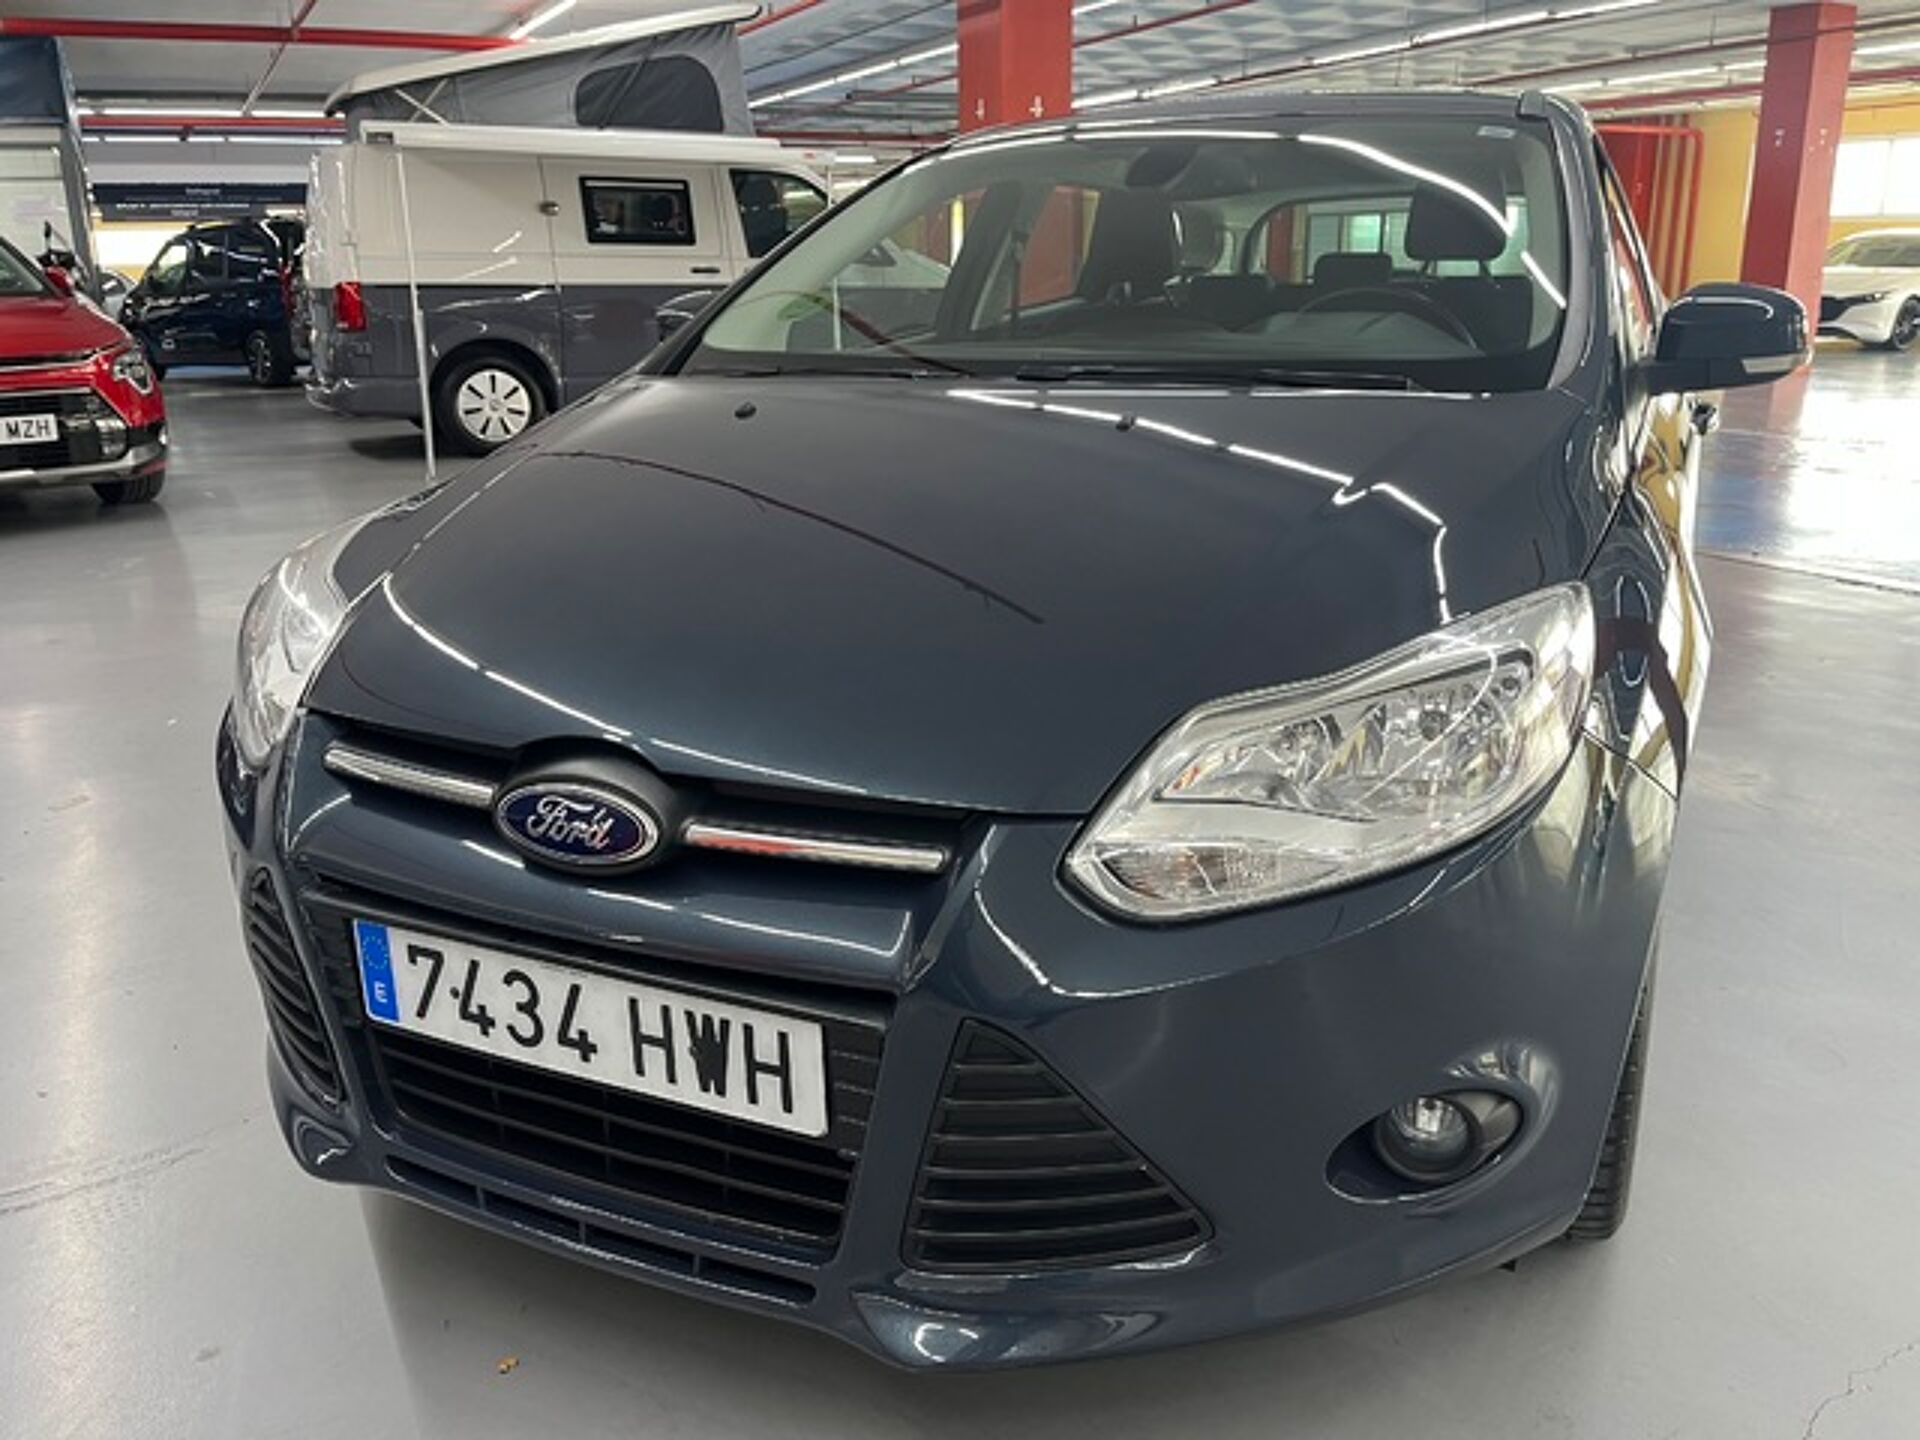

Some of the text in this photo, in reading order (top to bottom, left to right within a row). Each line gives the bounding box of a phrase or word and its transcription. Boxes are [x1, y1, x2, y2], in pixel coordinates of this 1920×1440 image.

[5, 419, 51, 439] MZH
[527, 795, 615, 849] Ford
[373, 981, 387, 1003] E
[407, 944, 793, 1114] 7434 HWH
